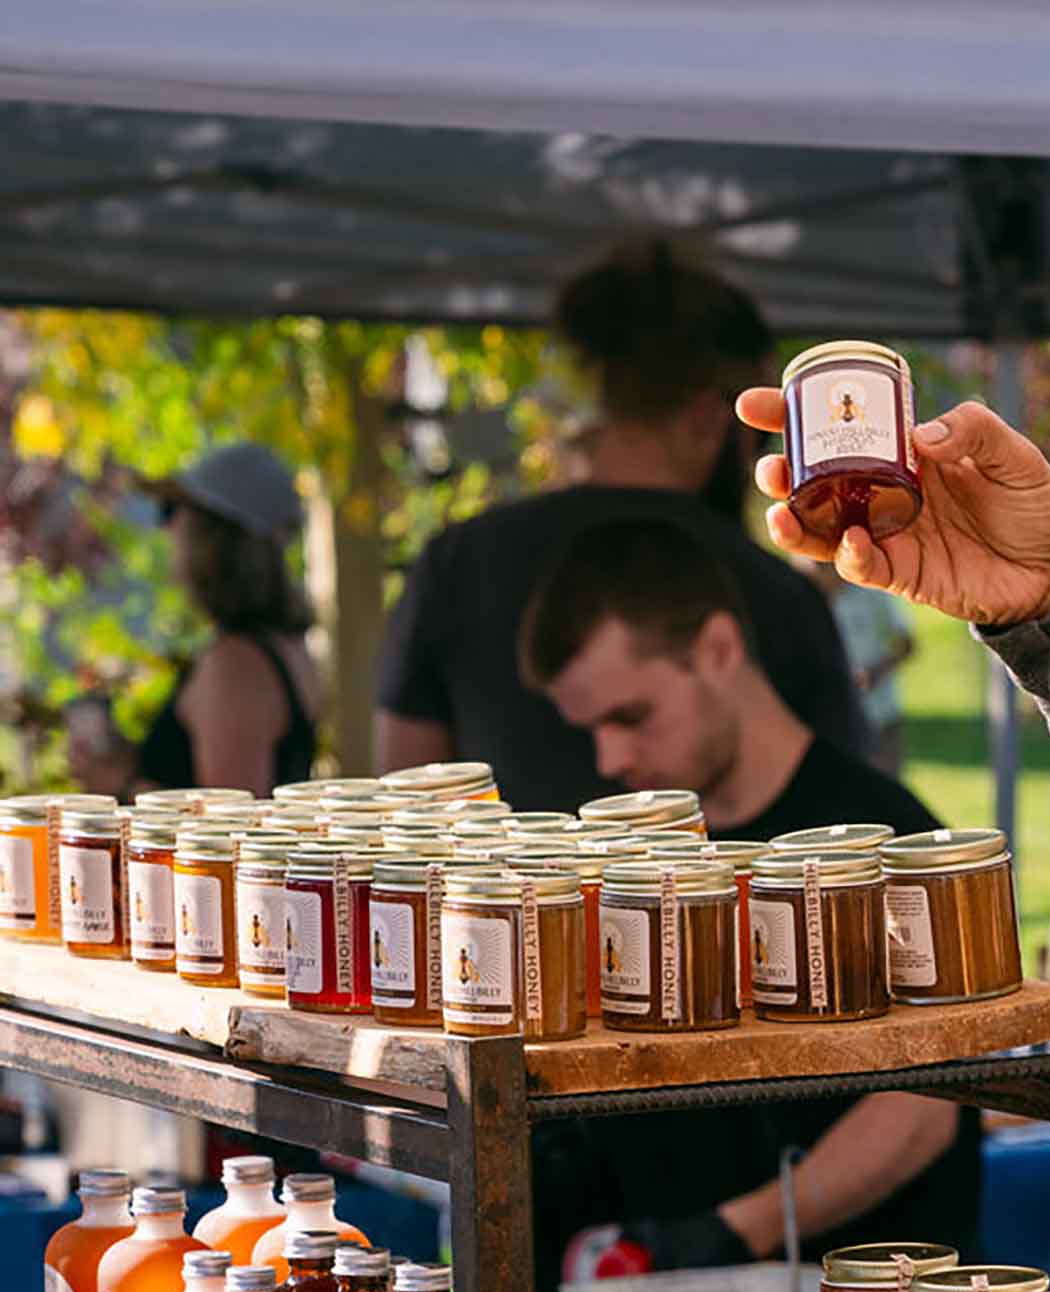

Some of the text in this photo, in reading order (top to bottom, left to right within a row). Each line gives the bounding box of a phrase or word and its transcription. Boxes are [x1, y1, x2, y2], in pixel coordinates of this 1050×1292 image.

[335, 857, 351, 989] HILLBILLY HONEY
[429, 868, 442, 1006] HILLBILLY HONEY
[527, 956, 541, 1012] HONEY
[663, 873, 675, 1013] HILLBILLY HONEY
[805, 863, 824, 1000] HILLBILLY HONEY
